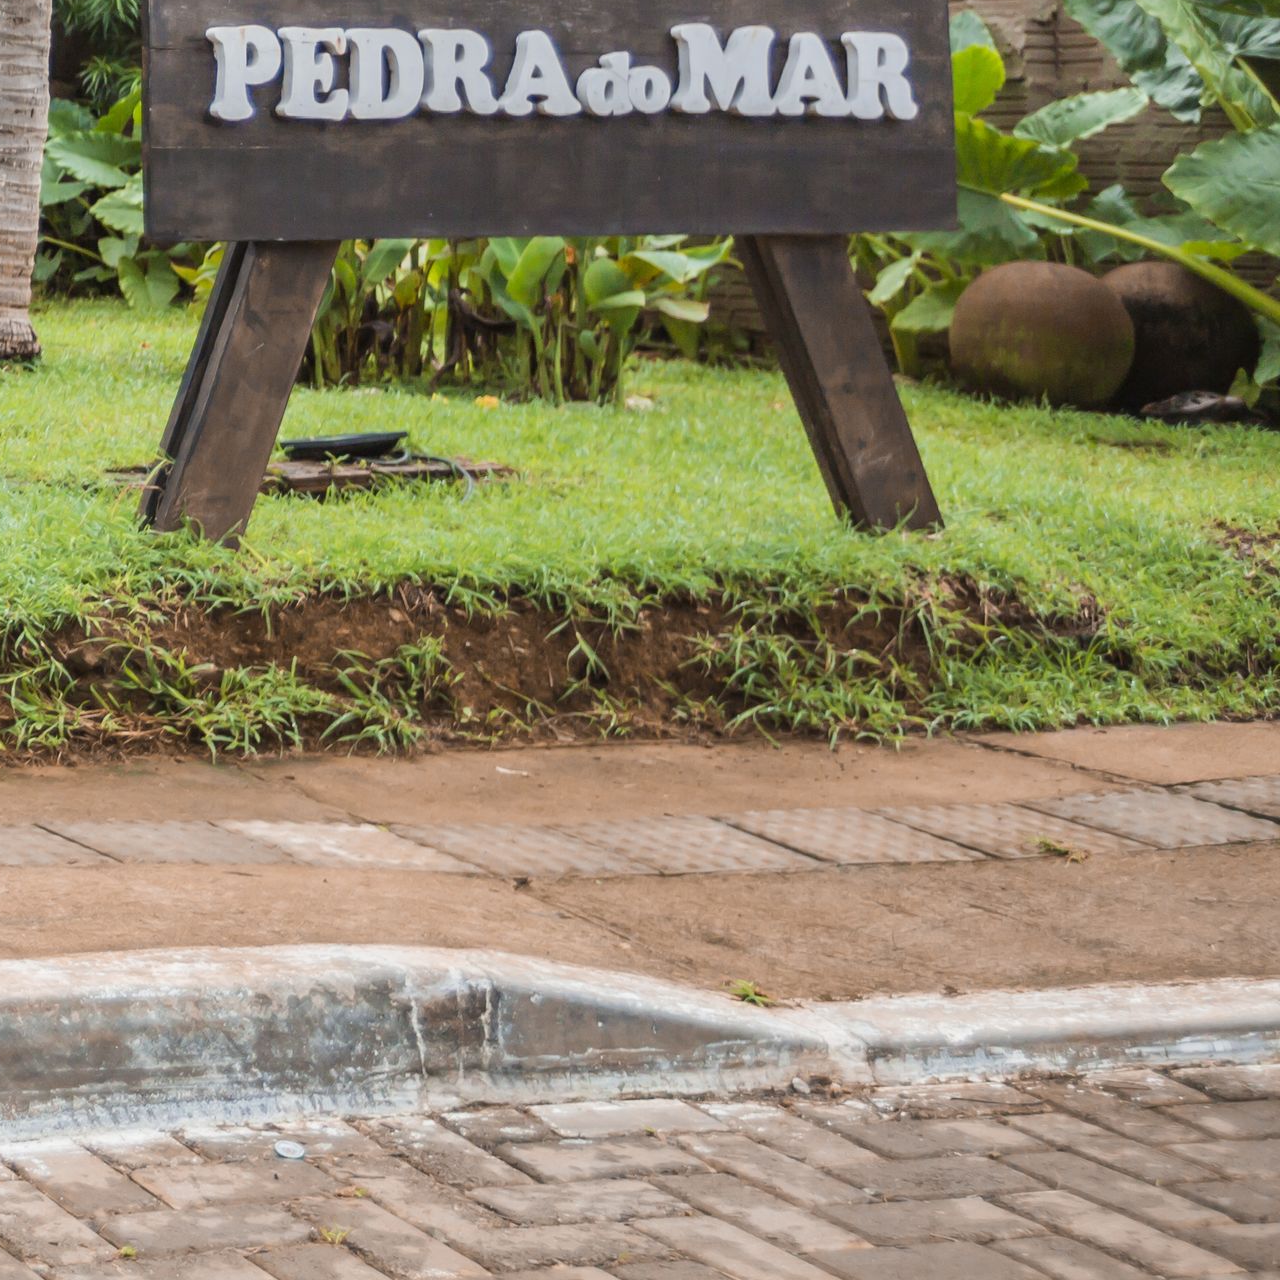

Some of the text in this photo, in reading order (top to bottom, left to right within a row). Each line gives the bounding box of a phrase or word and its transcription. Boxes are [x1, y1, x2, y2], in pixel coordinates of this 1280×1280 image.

[206, 24, 918, 121] PEDRA do MAR
